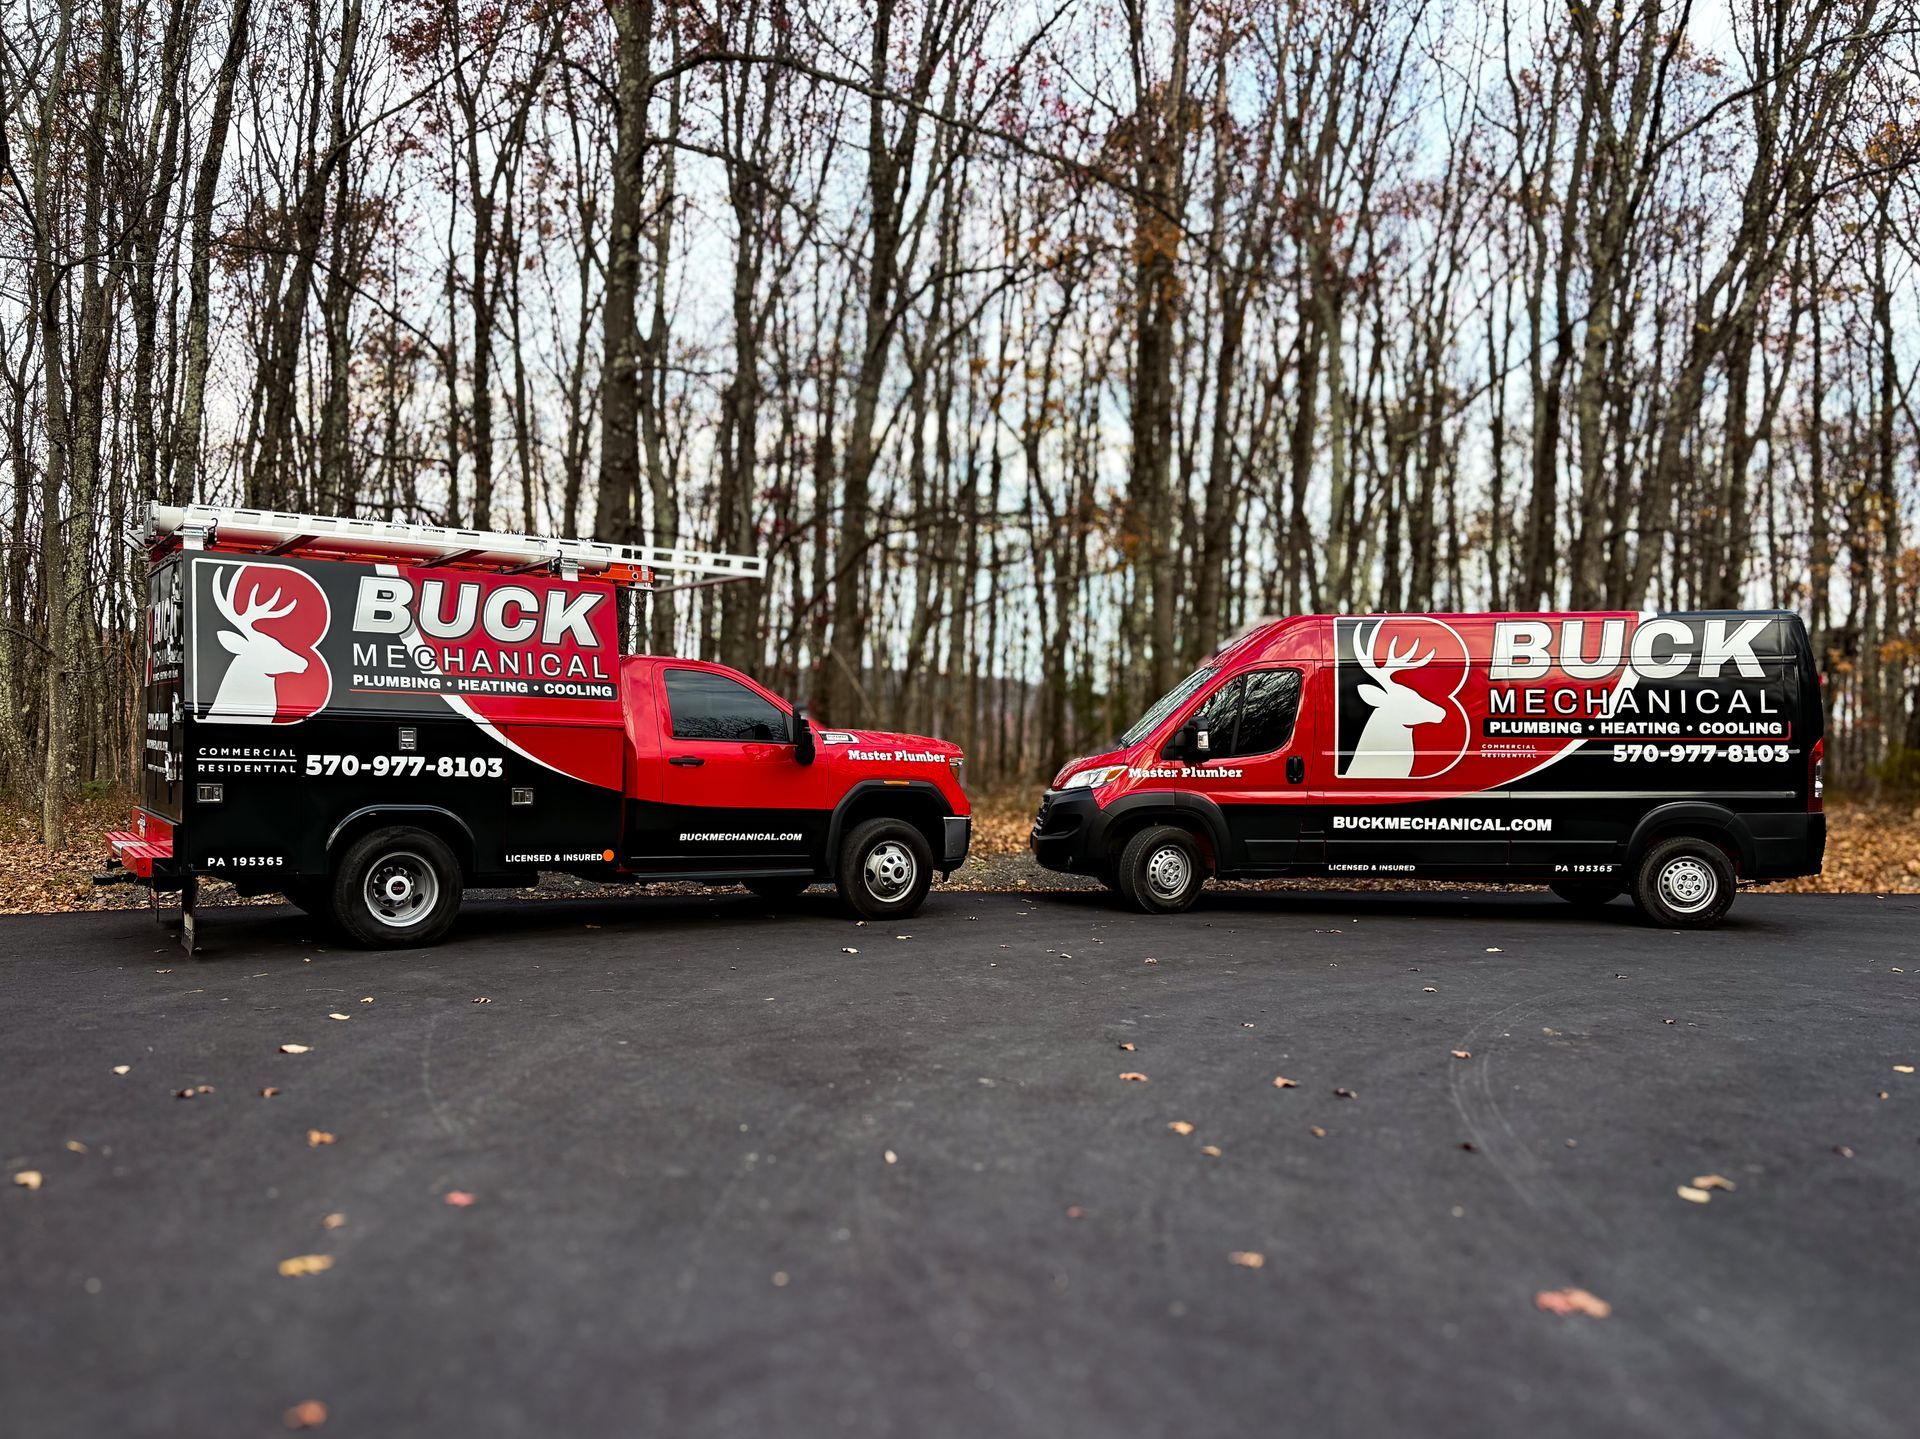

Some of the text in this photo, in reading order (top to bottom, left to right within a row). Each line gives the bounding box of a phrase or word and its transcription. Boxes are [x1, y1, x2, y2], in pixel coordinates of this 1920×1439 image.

[352, 575, 604, 647] BUCK
[1488, 618, 1773, 680] BUCK
[352, 642, 609, 679] MECHANICAL
[353, 674, 613, 697] PLUMBING HEATING COOLING
[1490, 689, 1778, 714] MECHANICAL
[1489, 721, 1783, 735] PLUMBING HEATING COOLING
[198, 747, 296, 757] COMMERCIAL
[848, 749, 946, 763] Master Plumber
[1613, 744, 1789, 763] 570-977-8103
[197, 764, 296, 773] RESIDENTIAL
[305, 754, 503, 778] 570-977-8103
[1128, 766, 1243, 778] Master Plumber
[1333, 816, 1553, 832] BUCKMECHANICAL.COM
[679, 832, 803, 842] BUCKMECHANICAL.COM
[207, 857, 283, 867] PA 195365
[505, 854, 603, 863] LICENSED & INSURED
[1573, 865, 1613, 873] 195365
